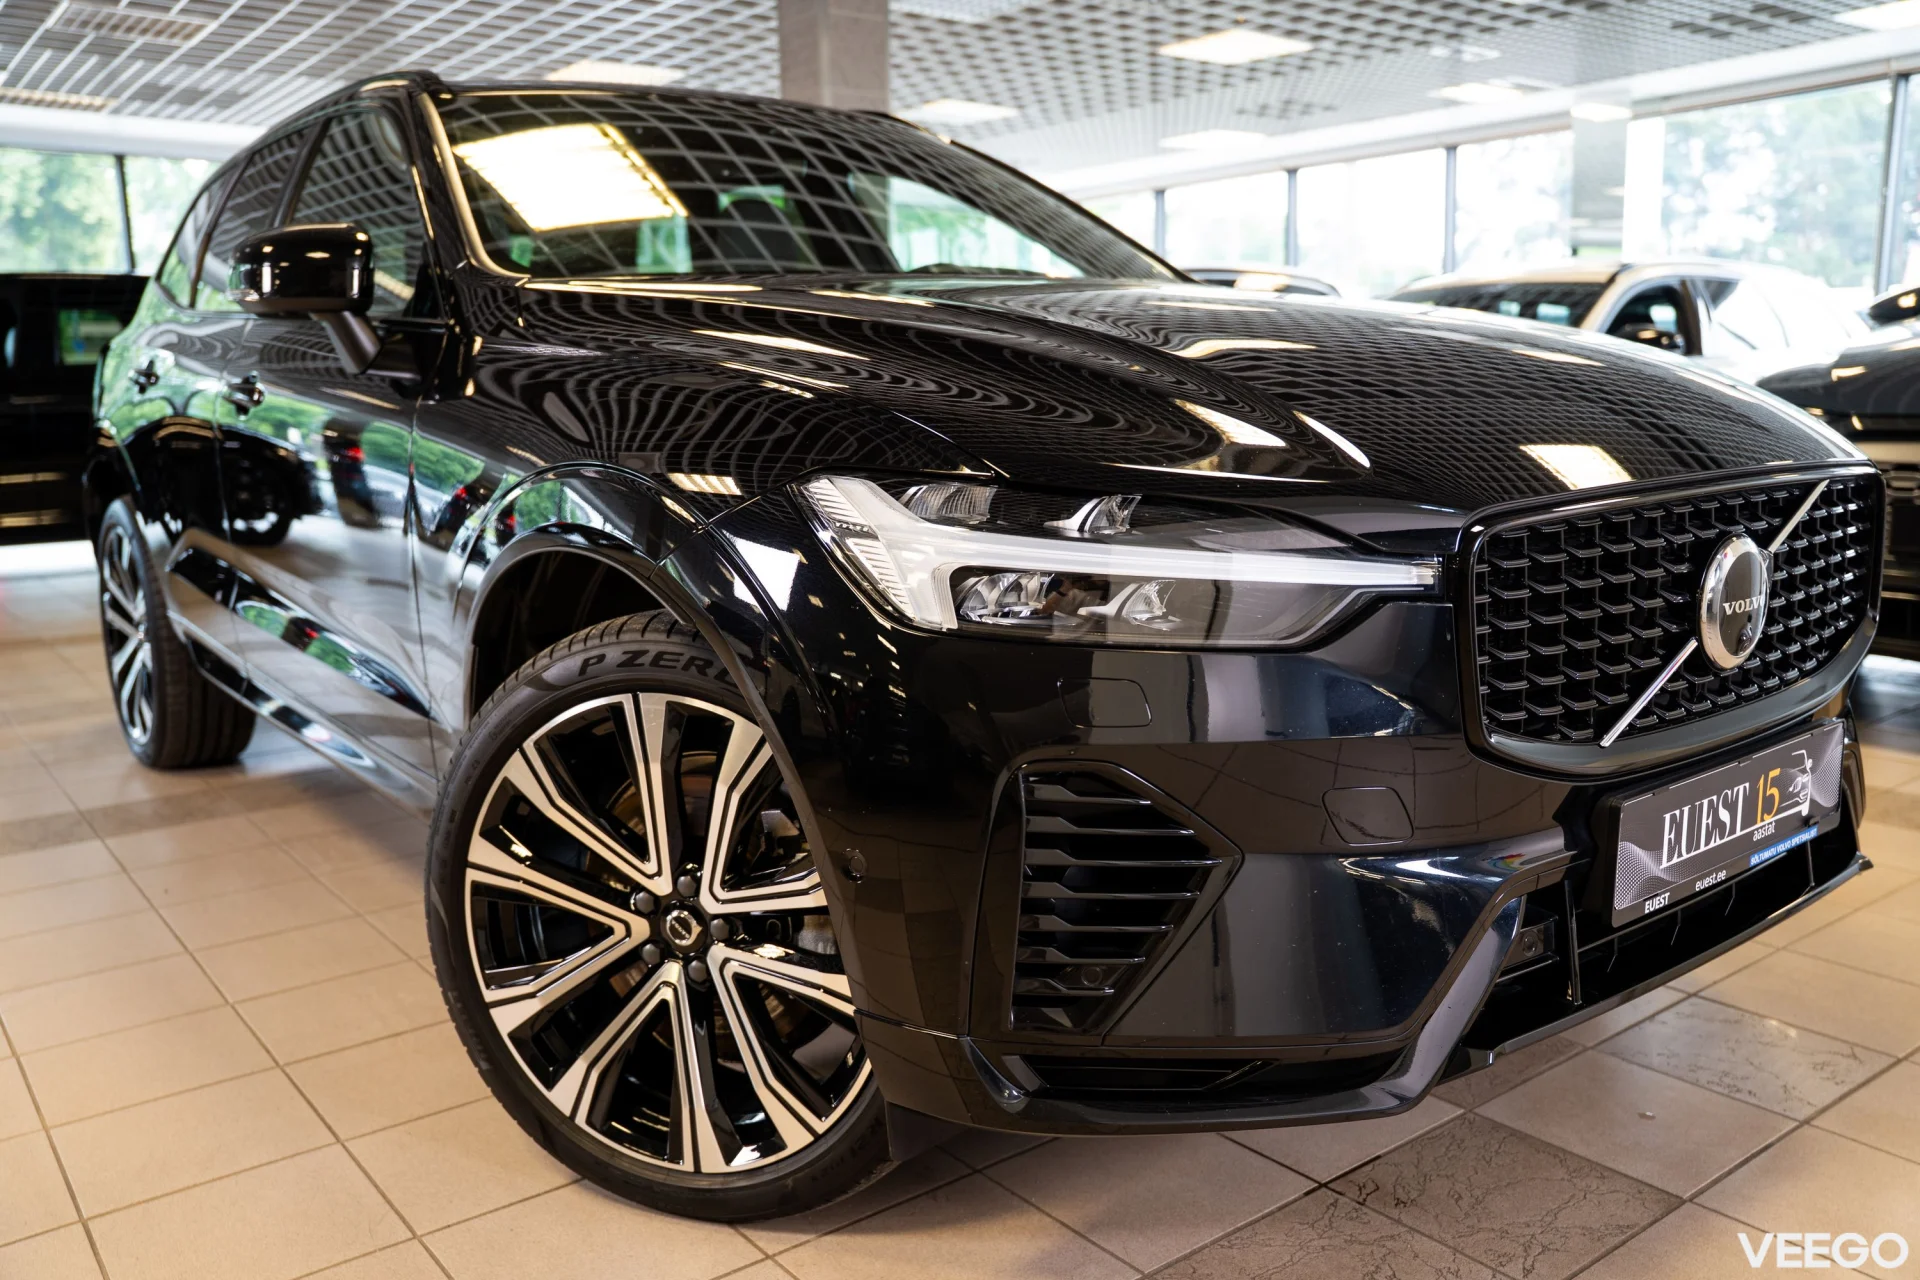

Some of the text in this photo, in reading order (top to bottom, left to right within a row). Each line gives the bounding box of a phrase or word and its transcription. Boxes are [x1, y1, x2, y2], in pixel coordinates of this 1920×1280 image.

[578, 653, 607, 677] P
[1660, 768, 1781, 868] EUEST 15
[1753, 821, 1775, 841] aastat
[1777, 840, 1792, 853] VOLVO
[1695, 869, 1726, 891] euest.ee
[1644, 892, 1670, 914] EUEST
